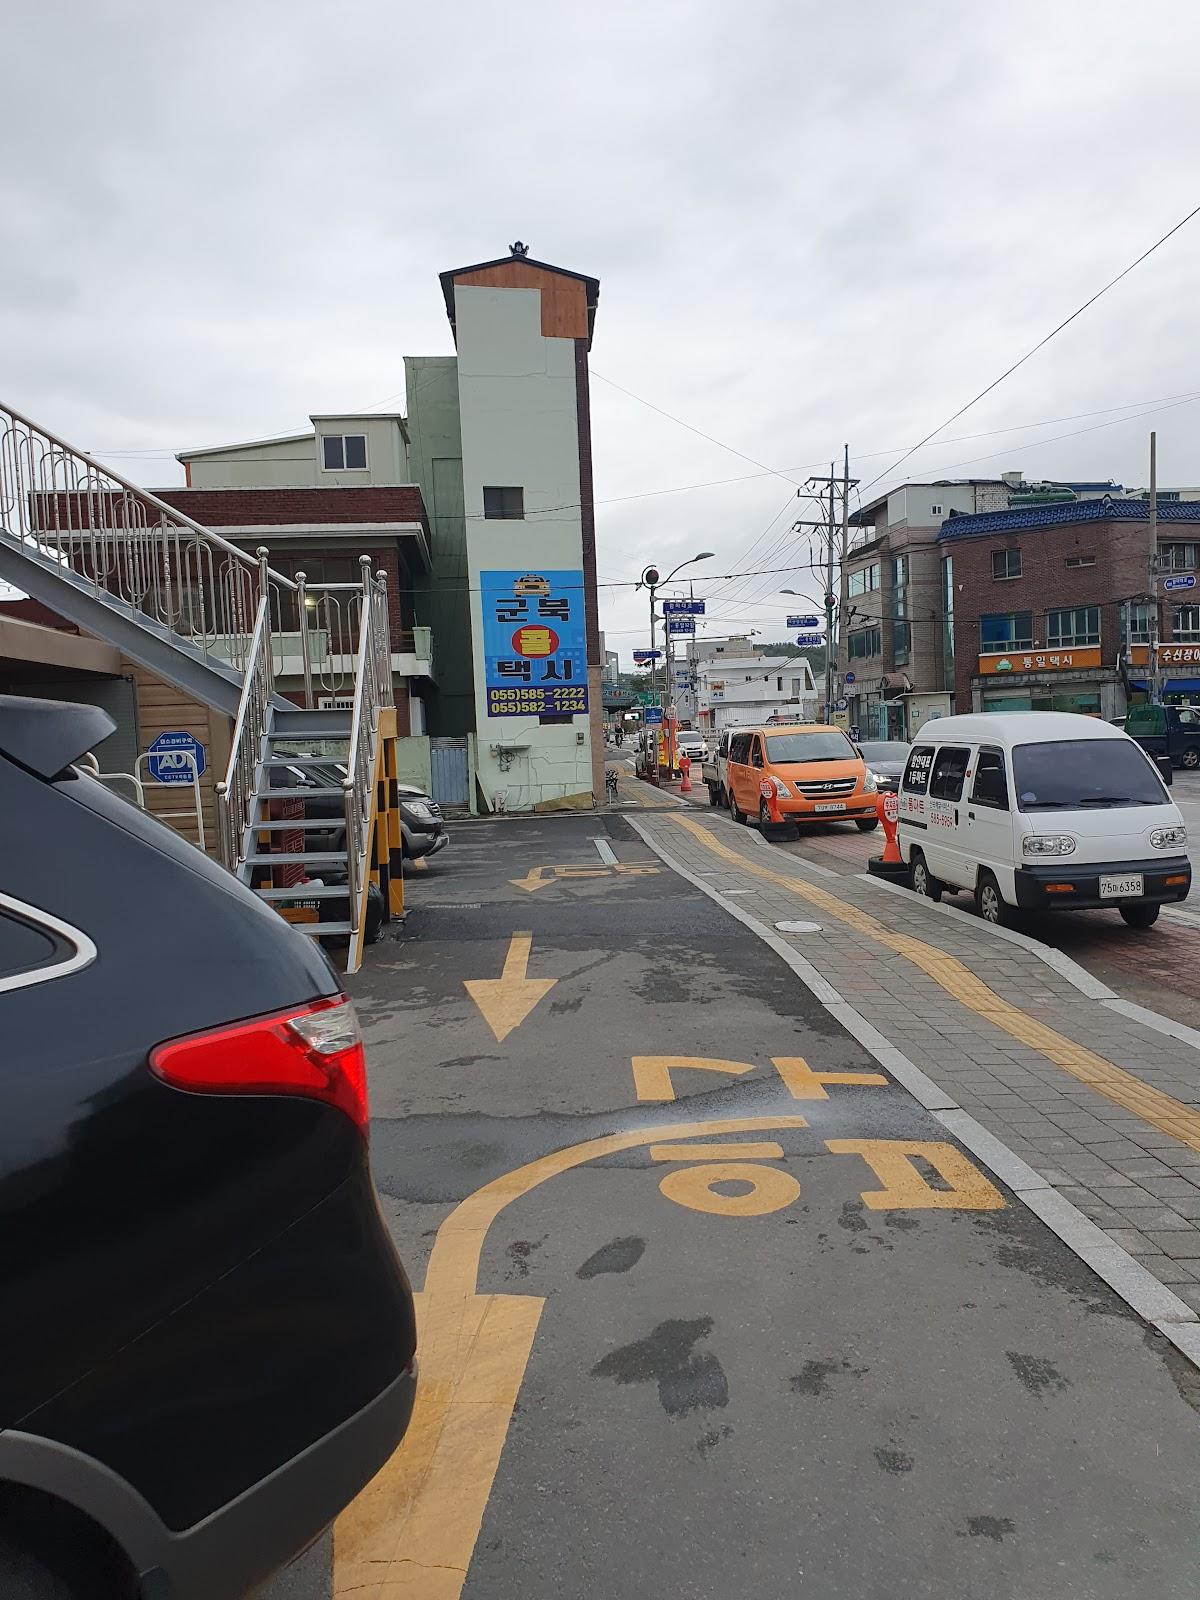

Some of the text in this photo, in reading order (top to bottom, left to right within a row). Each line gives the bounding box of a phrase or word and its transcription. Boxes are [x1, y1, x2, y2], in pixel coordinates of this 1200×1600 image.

[495, 598, 570, 622] 군북
[520, 629, 551, 655] 콜
[497, 659, 573, 681] 택시
[1022, 655, 1073, 669] 통일택시
[490, 687, 585, 701] 055)585-2222
[490, 700, 586, 713] 055)582-1234
